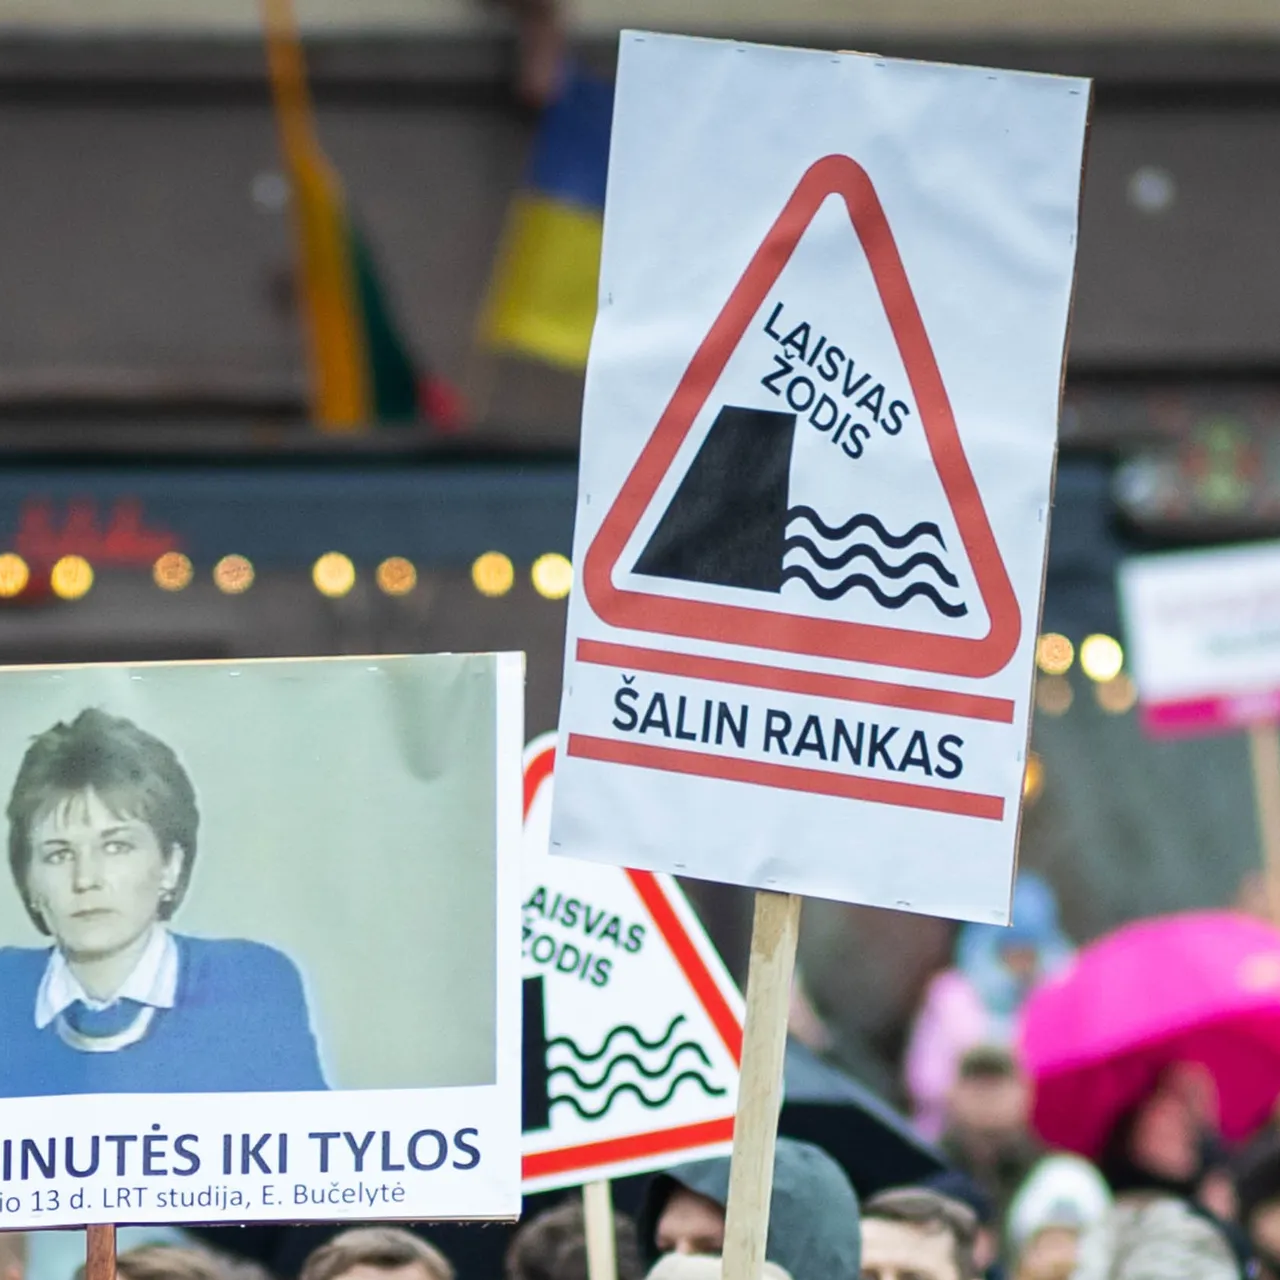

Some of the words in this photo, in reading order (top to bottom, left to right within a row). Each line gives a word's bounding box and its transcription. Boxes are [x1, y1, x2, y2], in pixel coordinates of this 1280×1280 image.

[760, 347, 871, 460] ŽODIS
[763, 302, 910, 437] LAISVAS
[612, 675, 749, 749] ŠALIN
[762, 709, 965, 780] RANKAS
[521, 884, 645, 953] AISVAS
[31, 1188, 61, 1213] 13
[69, 1184, 93, 1210] d.
[102, 1186, 146, 1209] LRT
[155, 1182, 252, 1211] studija,
[261, 1182, 285, 1206] E.
[294, 1173, 406, 1210] Bučelytė
[222, 1133, 288, 1175] IKI
[308, 1126, 481, 1172] TYLOS
